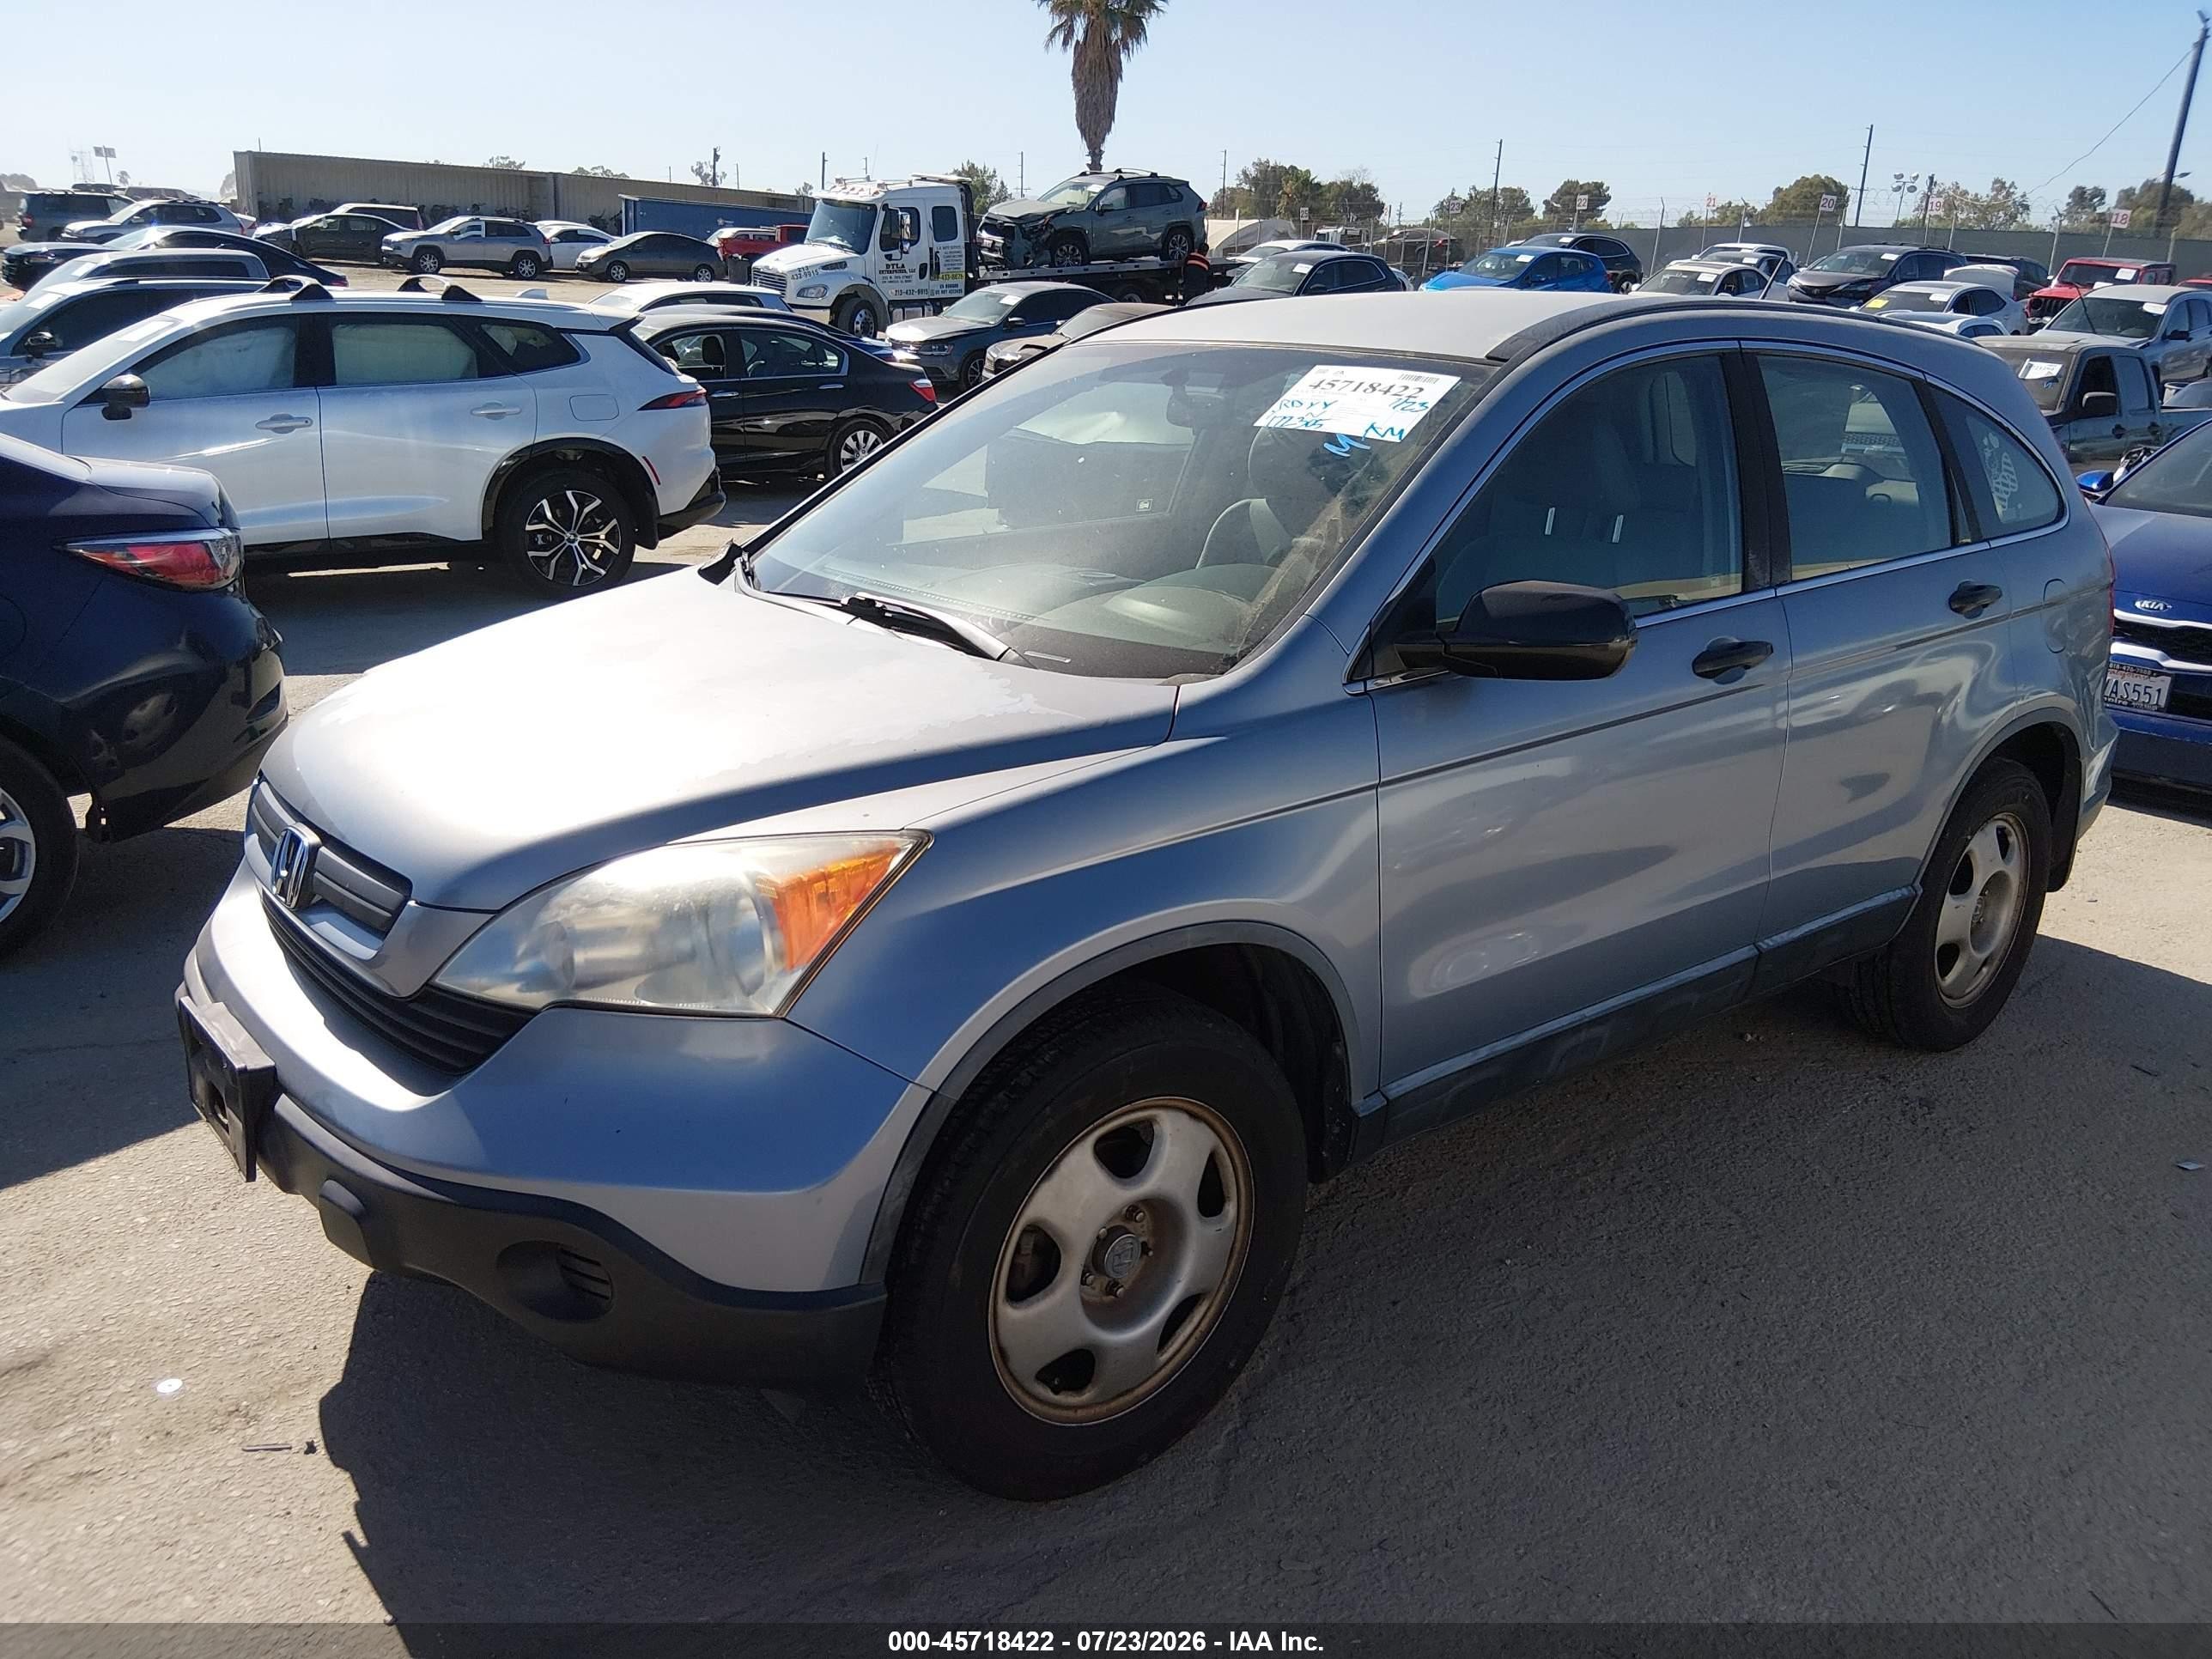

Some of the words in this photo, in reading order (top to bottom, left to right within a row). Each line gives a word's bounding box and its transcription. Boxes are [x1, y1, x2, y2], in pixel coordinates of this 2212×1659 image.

[1450, 203, 1461, 211] 23
[1577, 198, 1587, 207] 22
[1706, 198, 1716, 207] 21
[1820, 198, 1834, 208] 20
[1929, 201, 1942, 211] 19
[1300, 209, 1309, 219] 25
[2112, 212, 2128, 224] 18
[1309, 378, 1425, 399] 45718422
[2141, 600, 2165, 611] KIA
